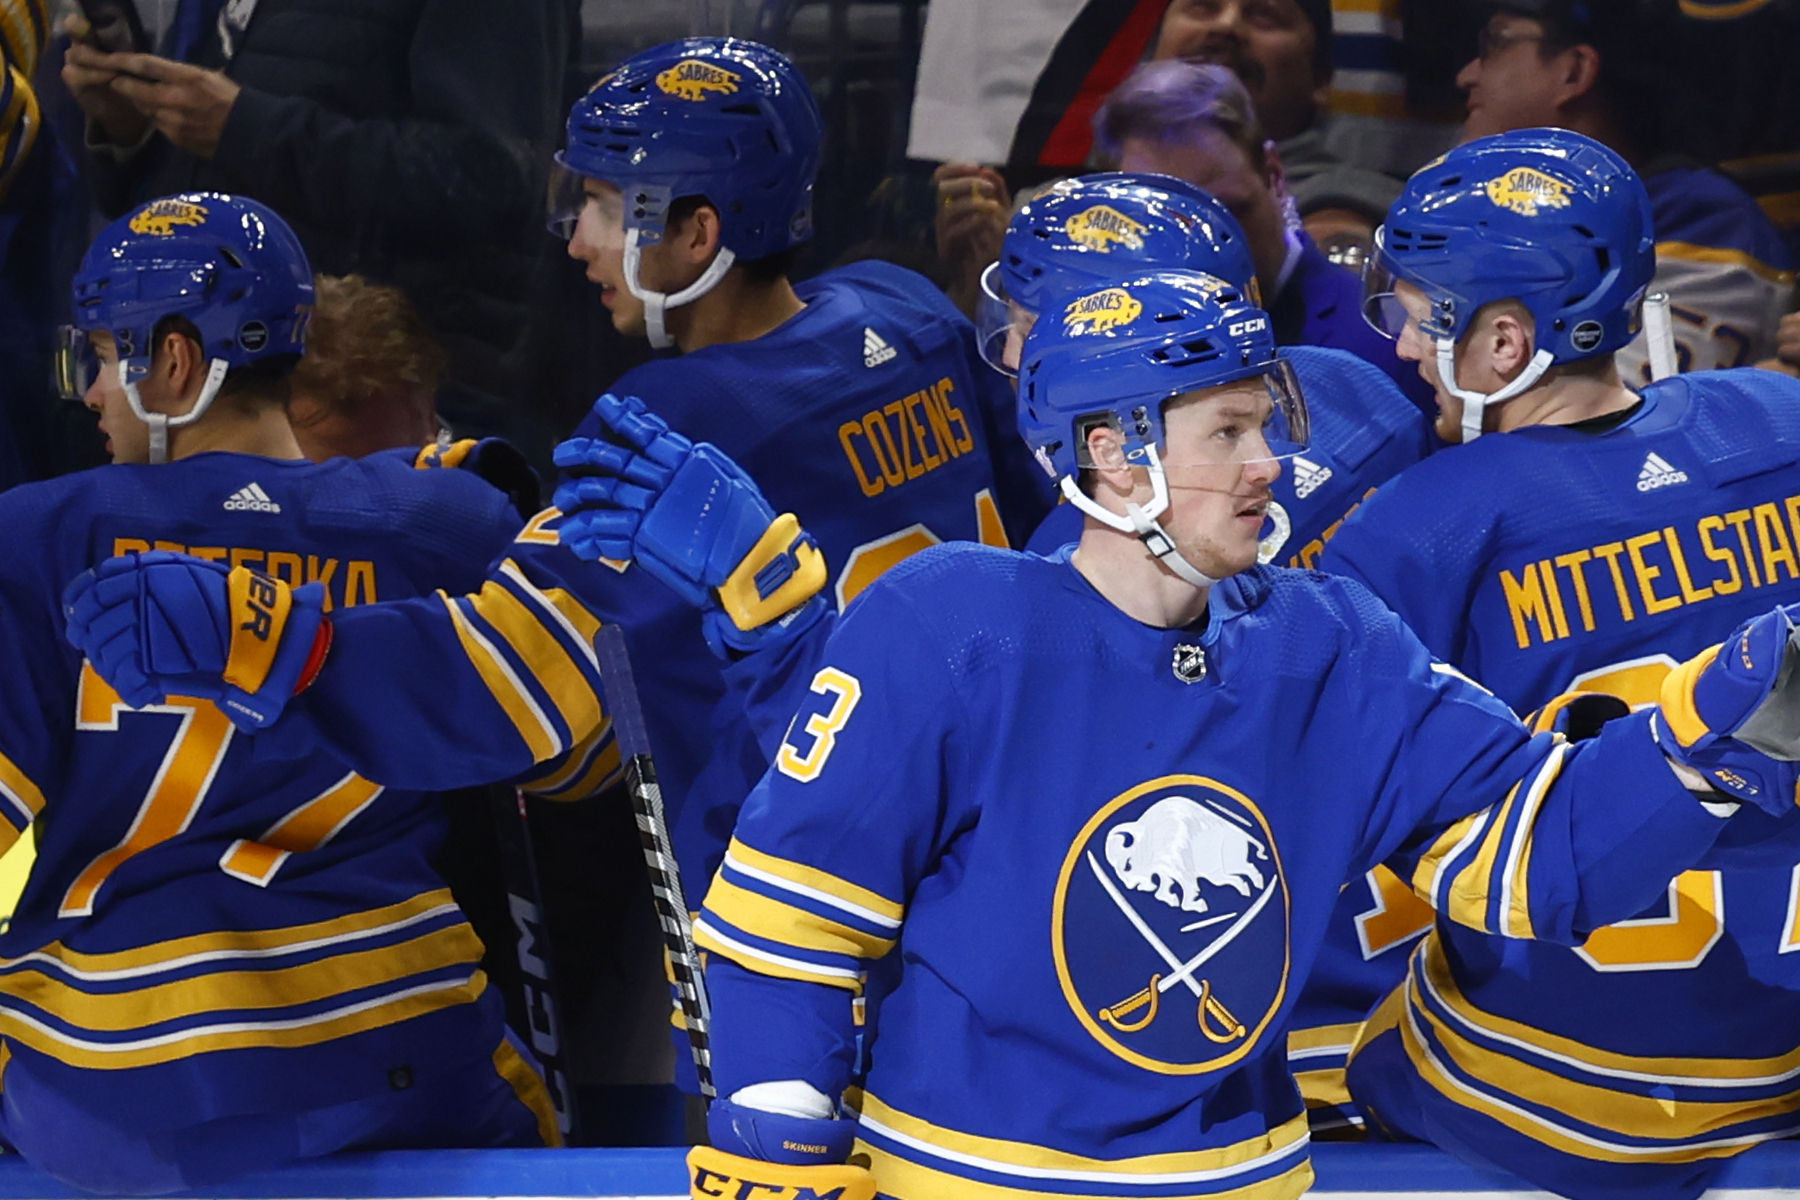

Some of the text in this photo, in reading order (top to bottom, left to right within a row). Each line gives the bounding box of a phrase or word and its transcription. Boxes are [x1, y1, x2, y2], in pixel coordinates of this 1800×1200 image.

[678, 63, 724, 84] SABRES
[1508, 172, 1558, 196] SABRES
[1086, 209, 1131, 236] SABRES
[1078, 293, 1124, 314] SABRES
[1228, 316, 1267, 337] CCM
[838, 377, 974, 497] COZENS
[1636, 468, 1688, 492] adidas
[222, 499, 281, 514] adidas
[782, 1139, 828, 1155] SKINNER
